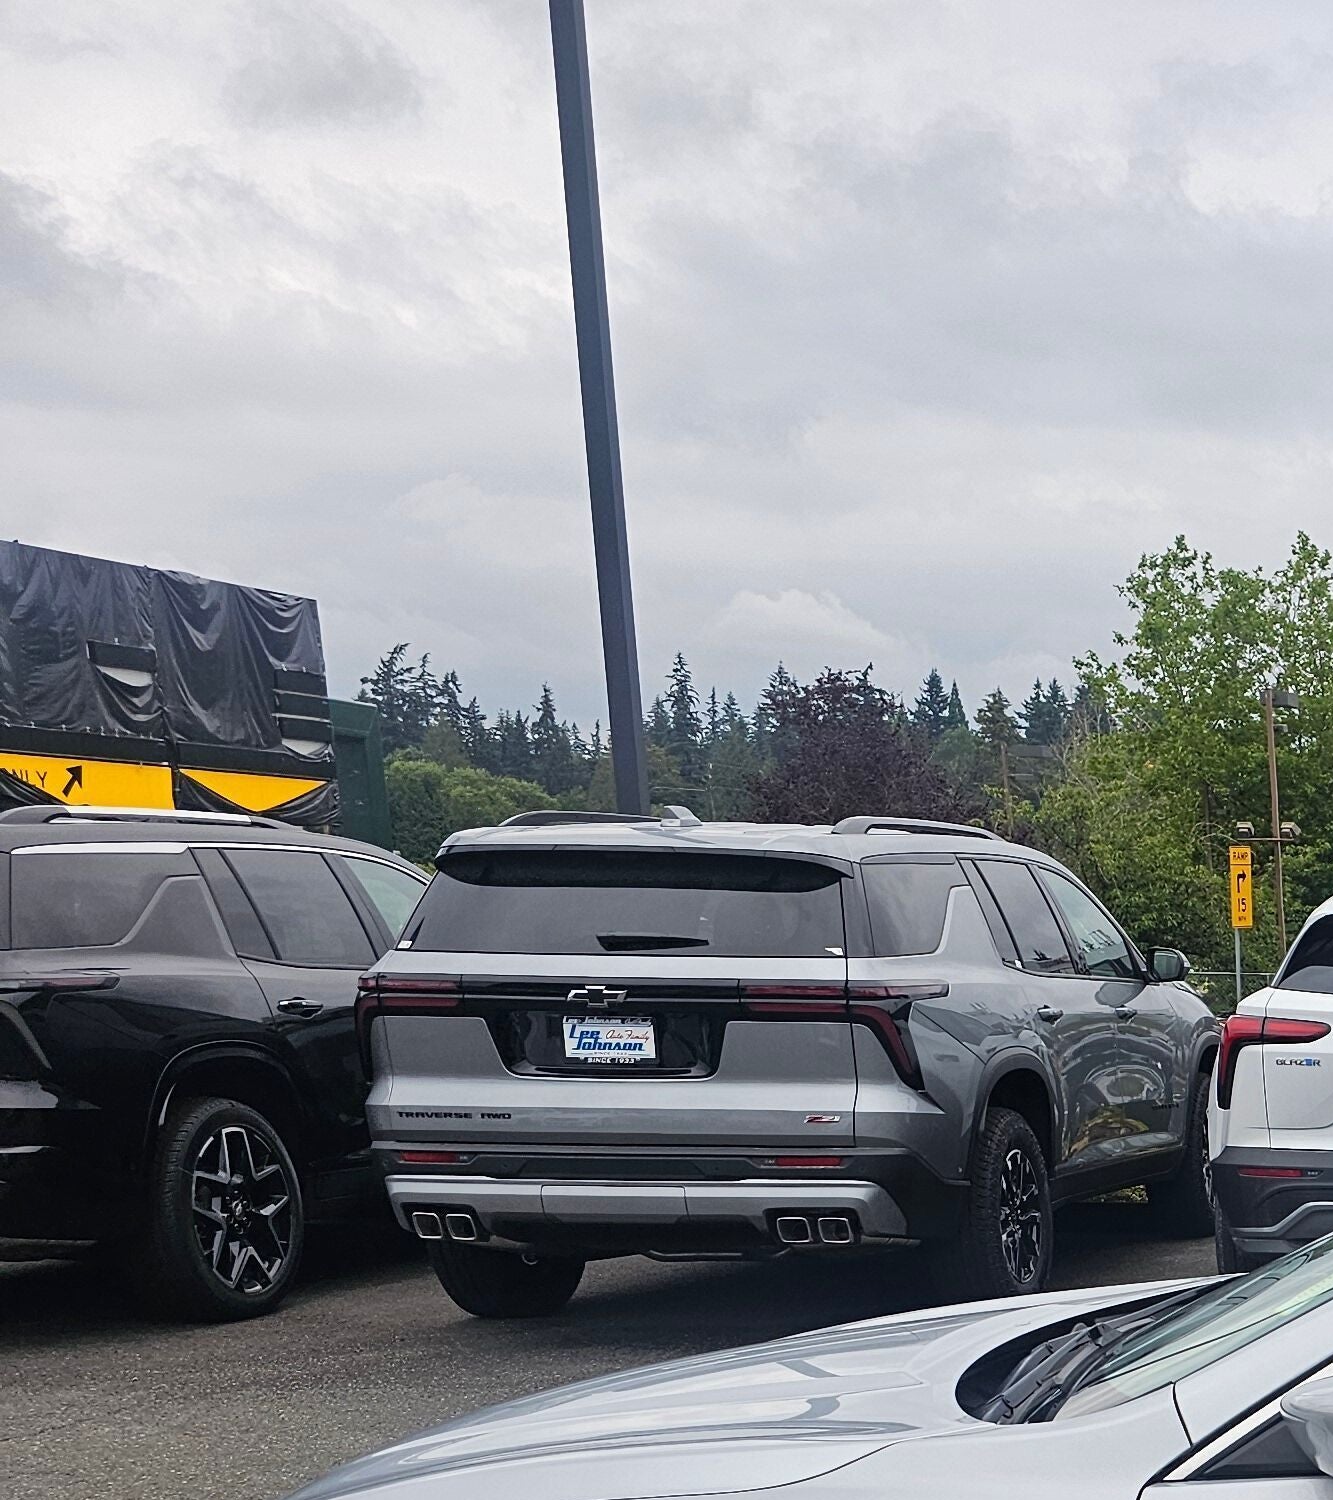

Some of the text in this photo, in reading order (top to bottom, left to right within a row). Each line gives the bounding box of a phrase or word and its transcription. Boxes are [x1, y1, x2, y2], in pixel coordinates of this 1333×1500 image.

[1232, 851, 1249, 860] RAMP
[1237, 897, 1247, 913] 15
[569, 1024, 602, 1039] Lee
[571, 1037, 645, 1051] Johnson
[396, 1111, 512, 1120] TRAVERSE AWD
